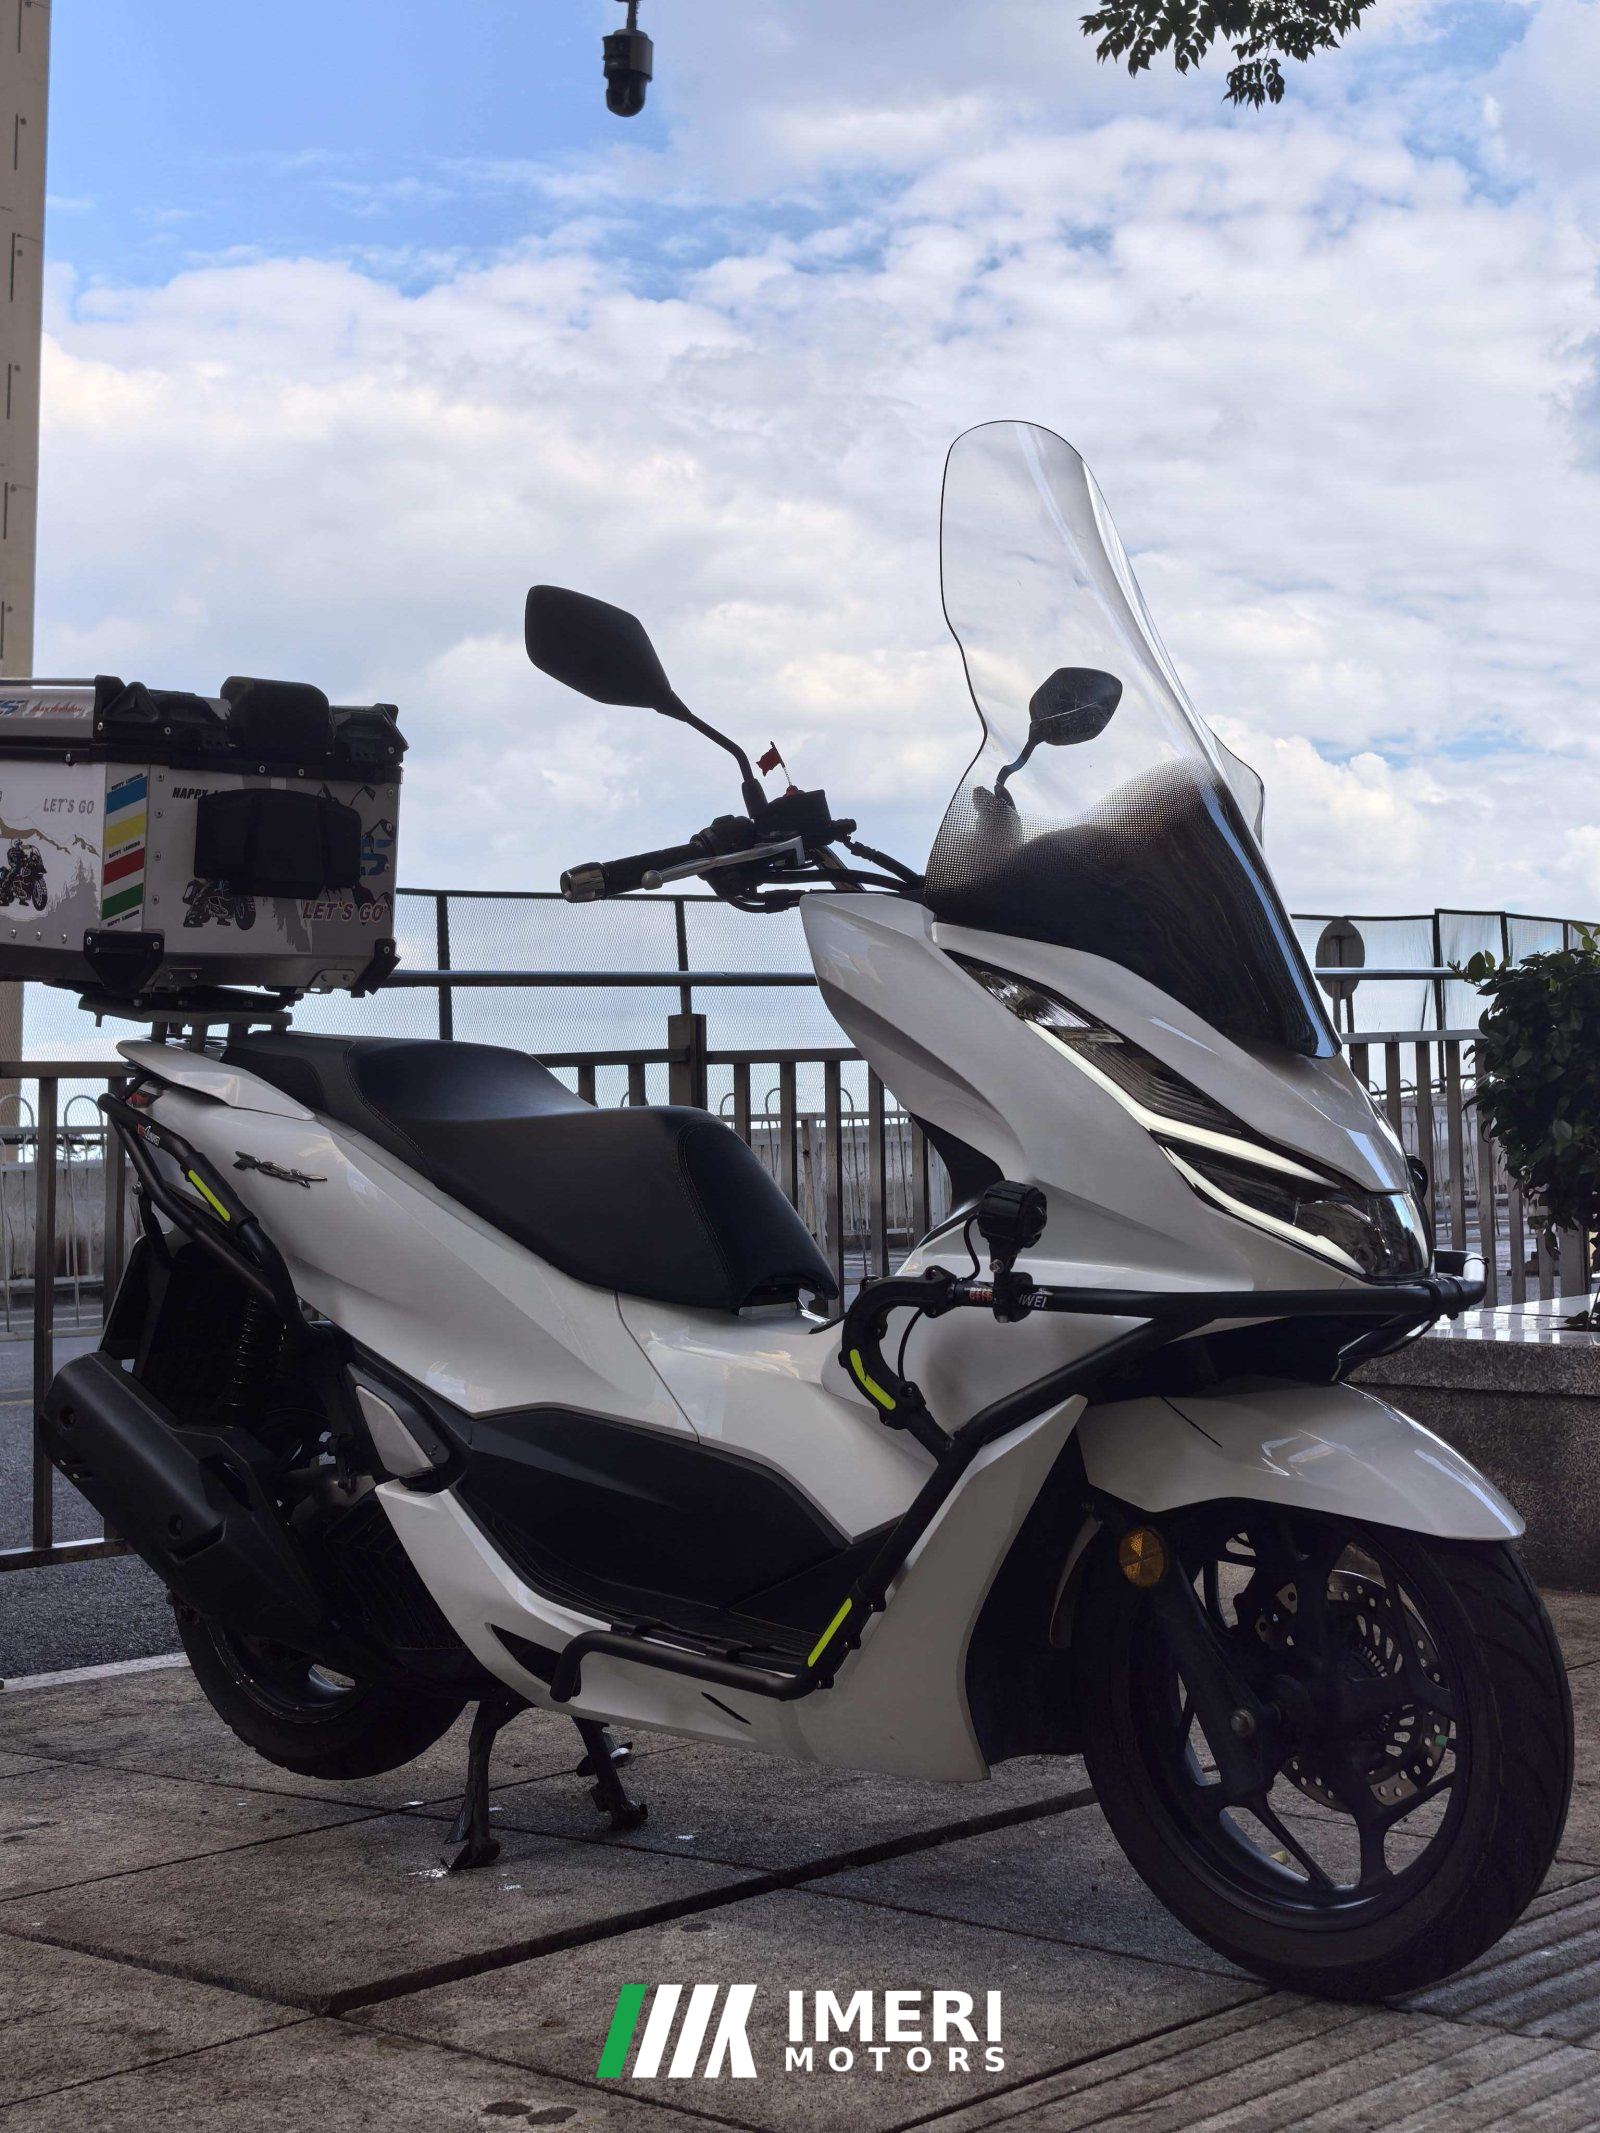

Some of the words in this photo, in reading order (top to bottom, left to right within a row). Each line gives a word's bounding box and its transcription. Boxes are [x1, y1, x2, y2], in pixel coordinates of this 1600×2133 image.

[171, 787, 209, 800] HAPPY
[43, 798, 74, 813] LET'S
[79, 800, 95, 814] GO
[359, 902, 384, 921] GO
